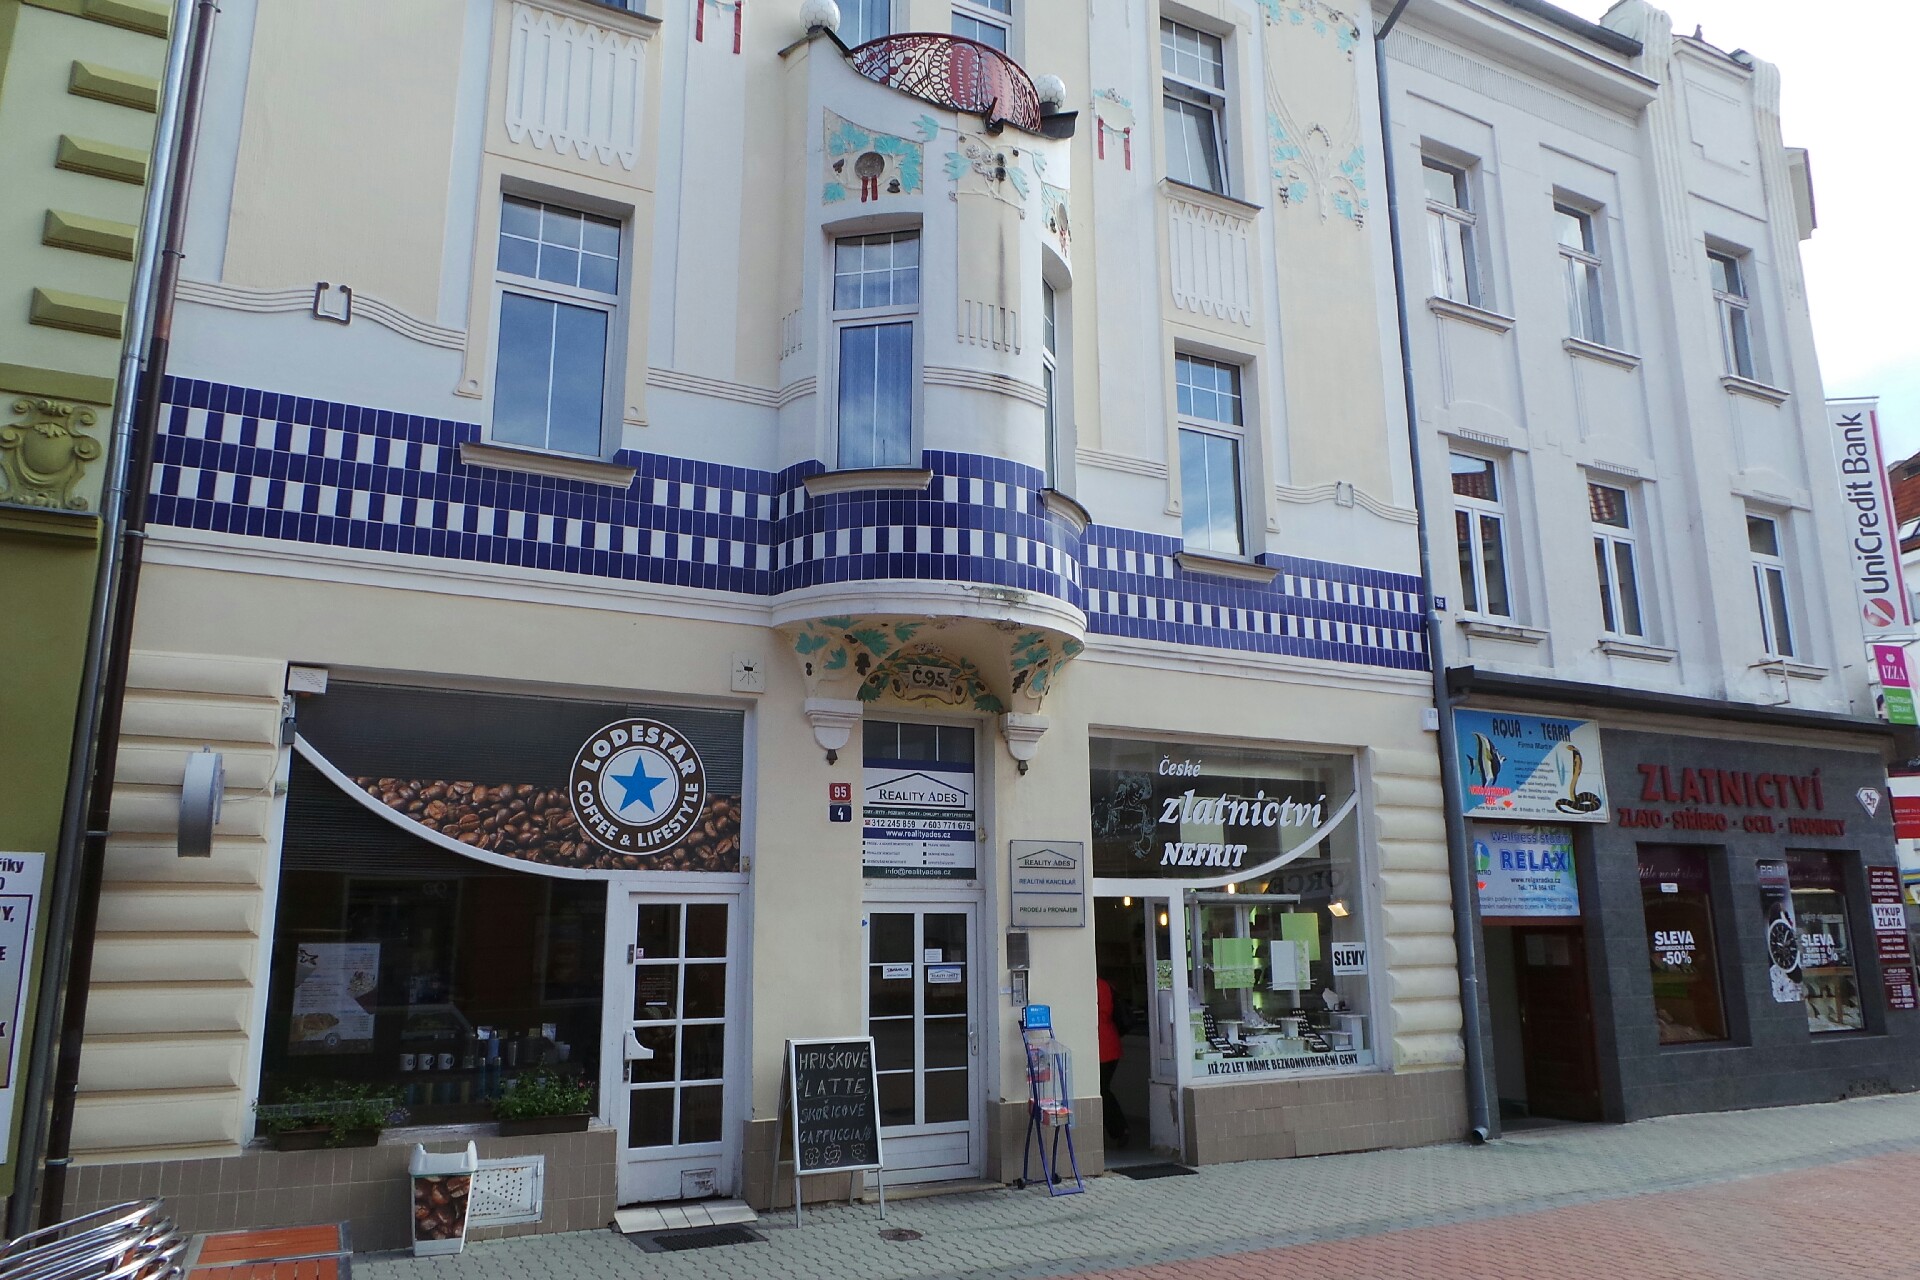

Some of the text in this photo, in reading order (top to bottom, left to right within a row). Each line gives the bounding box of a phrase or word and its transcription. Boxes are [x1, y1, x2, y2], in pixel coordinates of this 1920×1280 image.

[1835, 412, 1890, 594] UniCredit Bank
[1493, 717, 1571, 742] AQUA TERRA
[581, 725, 697, 778] LODESTAR
[1158, 755, 1201, 777] České
[834, 786, 847, 798] 95
[1638, 763, 1825, 811] ZLATNICTVÍ
[879, 789, 957, 803] REALITY ADES
[577, 780, 699, 847] COFFEE & LIFESTYLE
[837, 806, 844, 820] 4
[1617, 807, 1664, 829] ZLATO
[872, 819, 970, 830] 312 245 859 603 771 675
[886, 830, 951, 839] www.realityades.cz
[1160, 842, 1247, 867] NEFRIT
[1500, 849, 1569, 872] RELAX
[885, 868, 951, 876] info@realityades.cz
[1875, 905, 1900, 916] VÝKUP
[1878, 918, 1902, 927] ZLATA
[1655, 931, 1694, 945] SLEVA
[1801, 933, 1835, 946] SLEVA
[1334, 950, 1364, 966] SLEVY
[1663, 950, 1692, 965] -50%
[800, 1045, 869, 1071] HRUŠKOVÉ
[1208, 1053, 1358, 1074] JIŽ 22 LET MÁME BEZKONKURENČNÍ CENY
